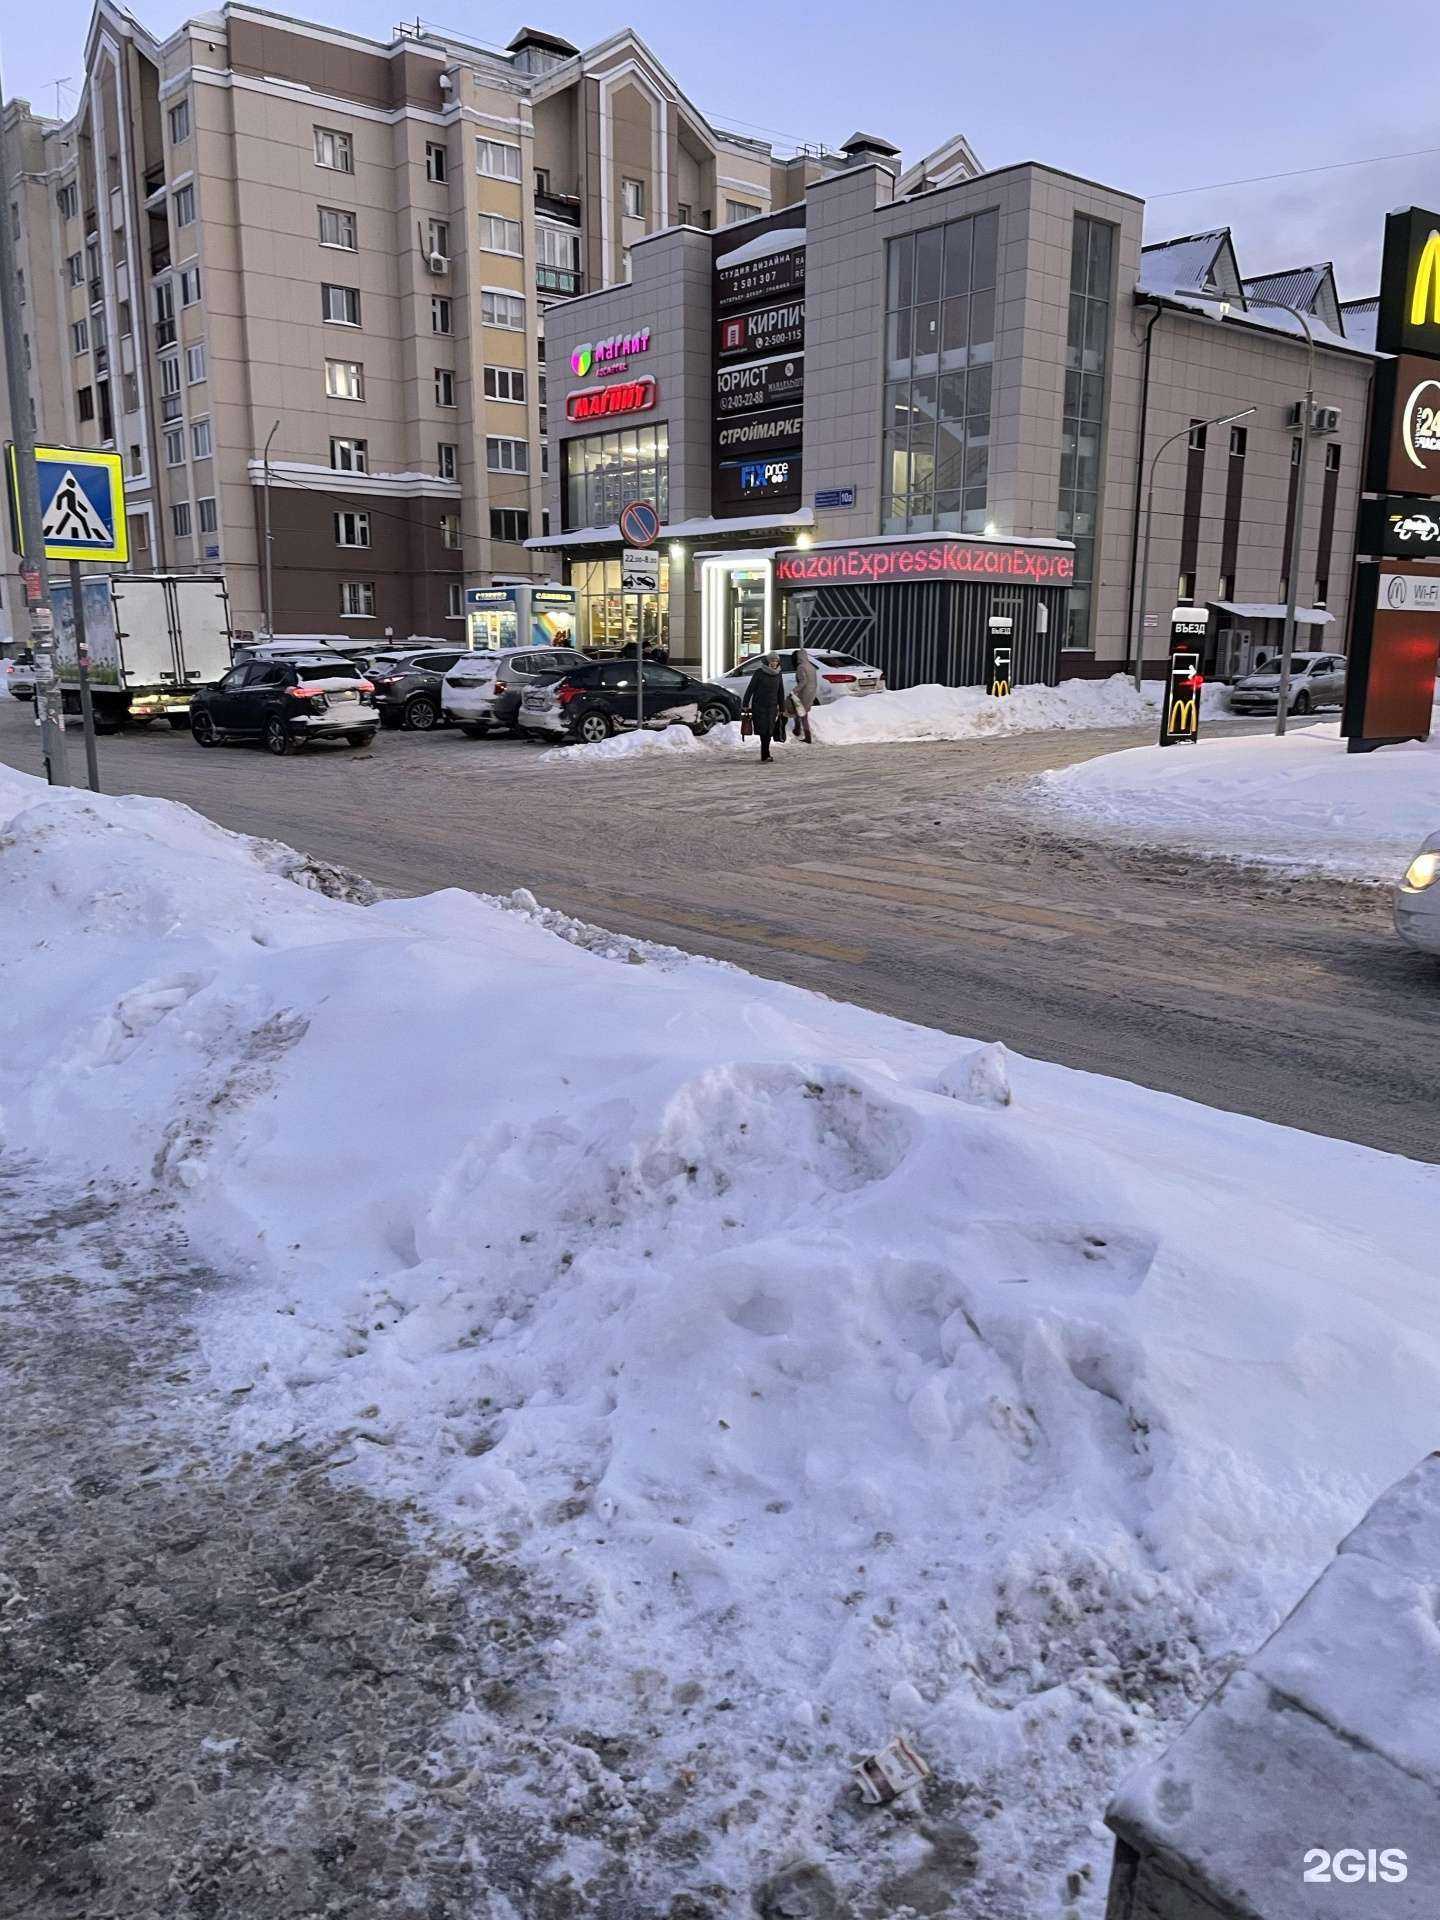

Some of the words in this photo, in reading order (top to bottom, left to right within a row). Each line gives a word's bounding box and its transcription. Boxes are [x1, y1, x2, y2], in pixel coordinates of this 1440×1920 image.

[720, 265, 750, 280] СТУДИЯ
[752, 254, 791, 272] ДИЗАЙНА
[765, 329, 802, 346] 2-500-115
[718, 366, 768, 392] ЮРИСТ
[574, 384, 646, 417] МАГНИТ
[1175, 623, 1206, 635] ВЪЕЗД
